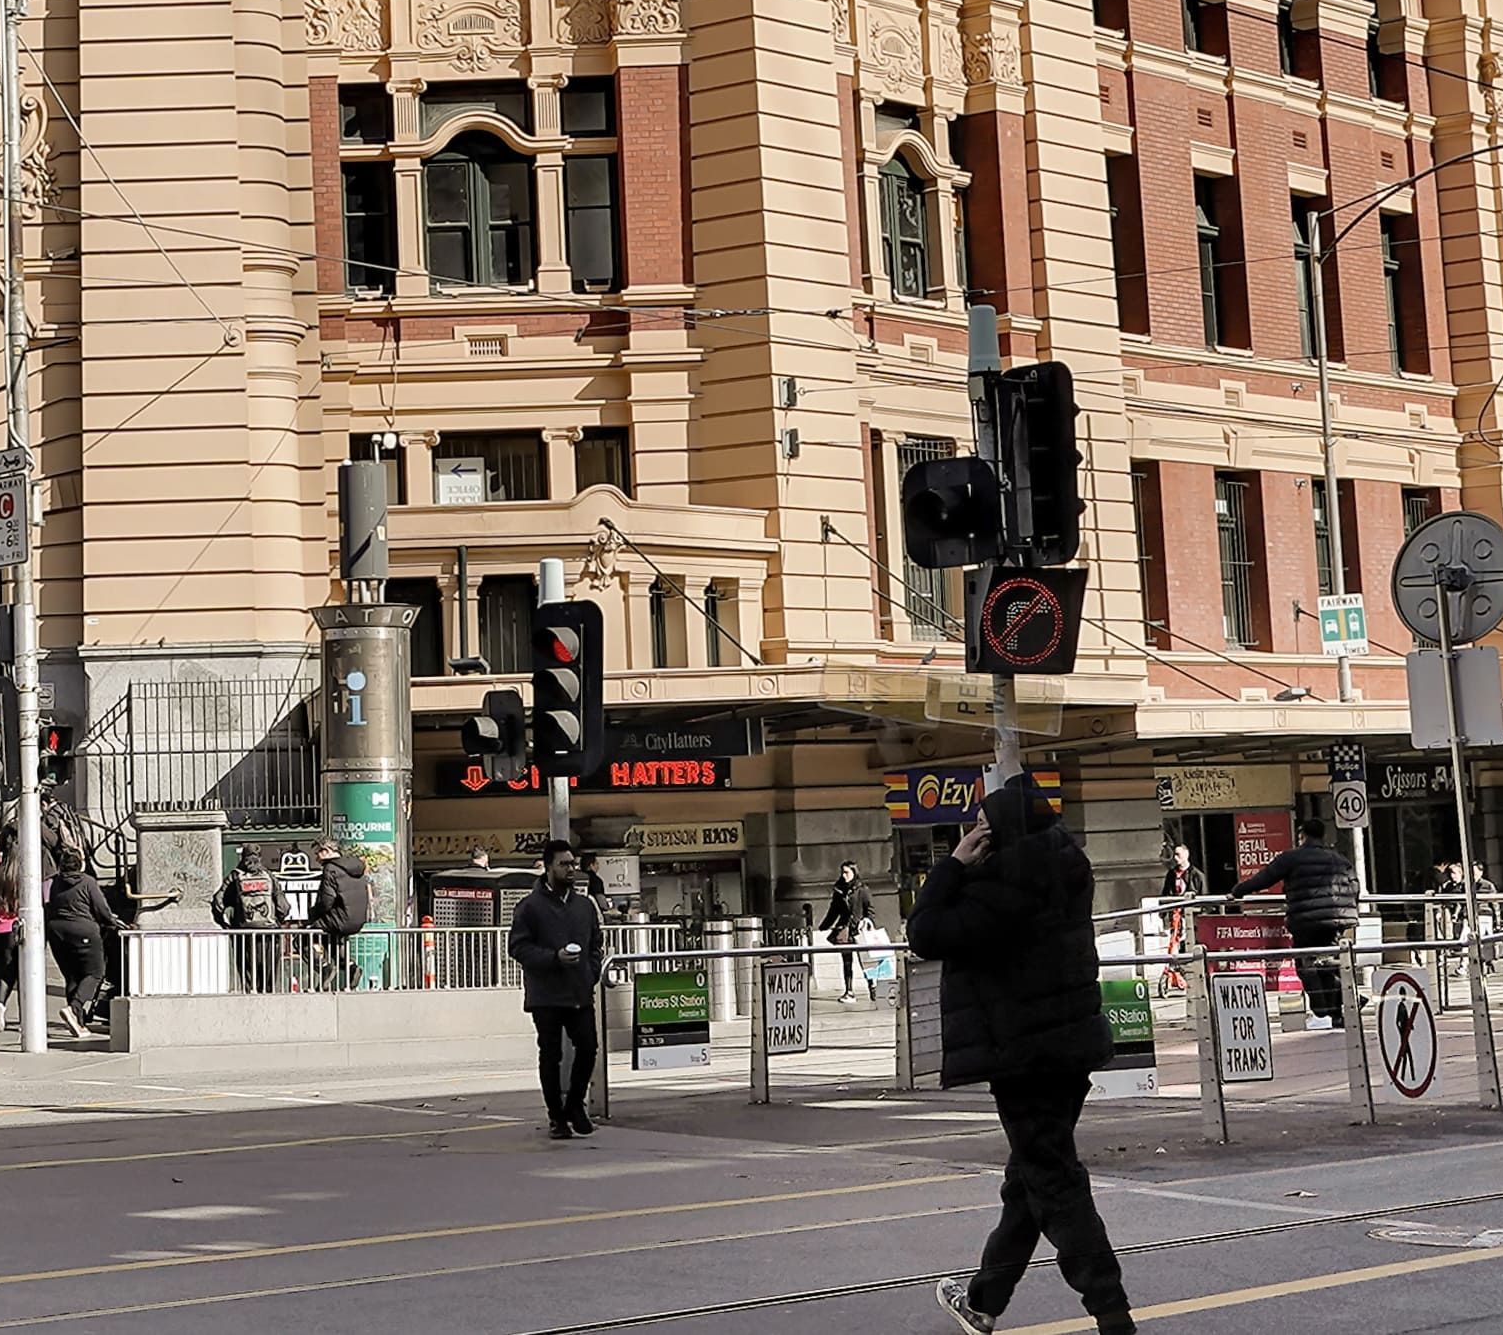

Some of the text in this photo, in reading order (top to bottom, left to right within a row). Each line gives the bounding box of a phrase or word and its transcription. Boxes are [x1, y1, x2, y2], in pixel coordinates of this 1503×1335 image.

[1321, 597, 1361, 608] FAIRWAY
[610, 760, 715, 787] HATTERS
[1335, 762, 1360, 771] Police
[1381, 765, 1427, 798] Scissors
[1339, 796, 1363, 815] 40
[646, 827, 739, 846] STETSON HATS
[1239, 840, 1268, 852] RETAIL
[1239, 853, 1257, 867] FOR
[1216, 927, 1233, 939] FIFA
[1233, 926, 1261, 939] Women's
[767, 972, 804, 995] WATCH
[640, 993, 706, 1009] Flinders St Station
[1220, 984, 1260, 1010] WATCH
[774, 999, 796, 1020] FOR
[1109, 1007, 1148, 1025] St Station
[767, 1024, 803, 1047] TRAMS
[1231, 1016, 1256, 1041] FOR
[700, 1048, 708, 1062] 5
[1226, 1046, 1267, 1073] TRAMS
[1147, 1073, 1154, 1090] 5
